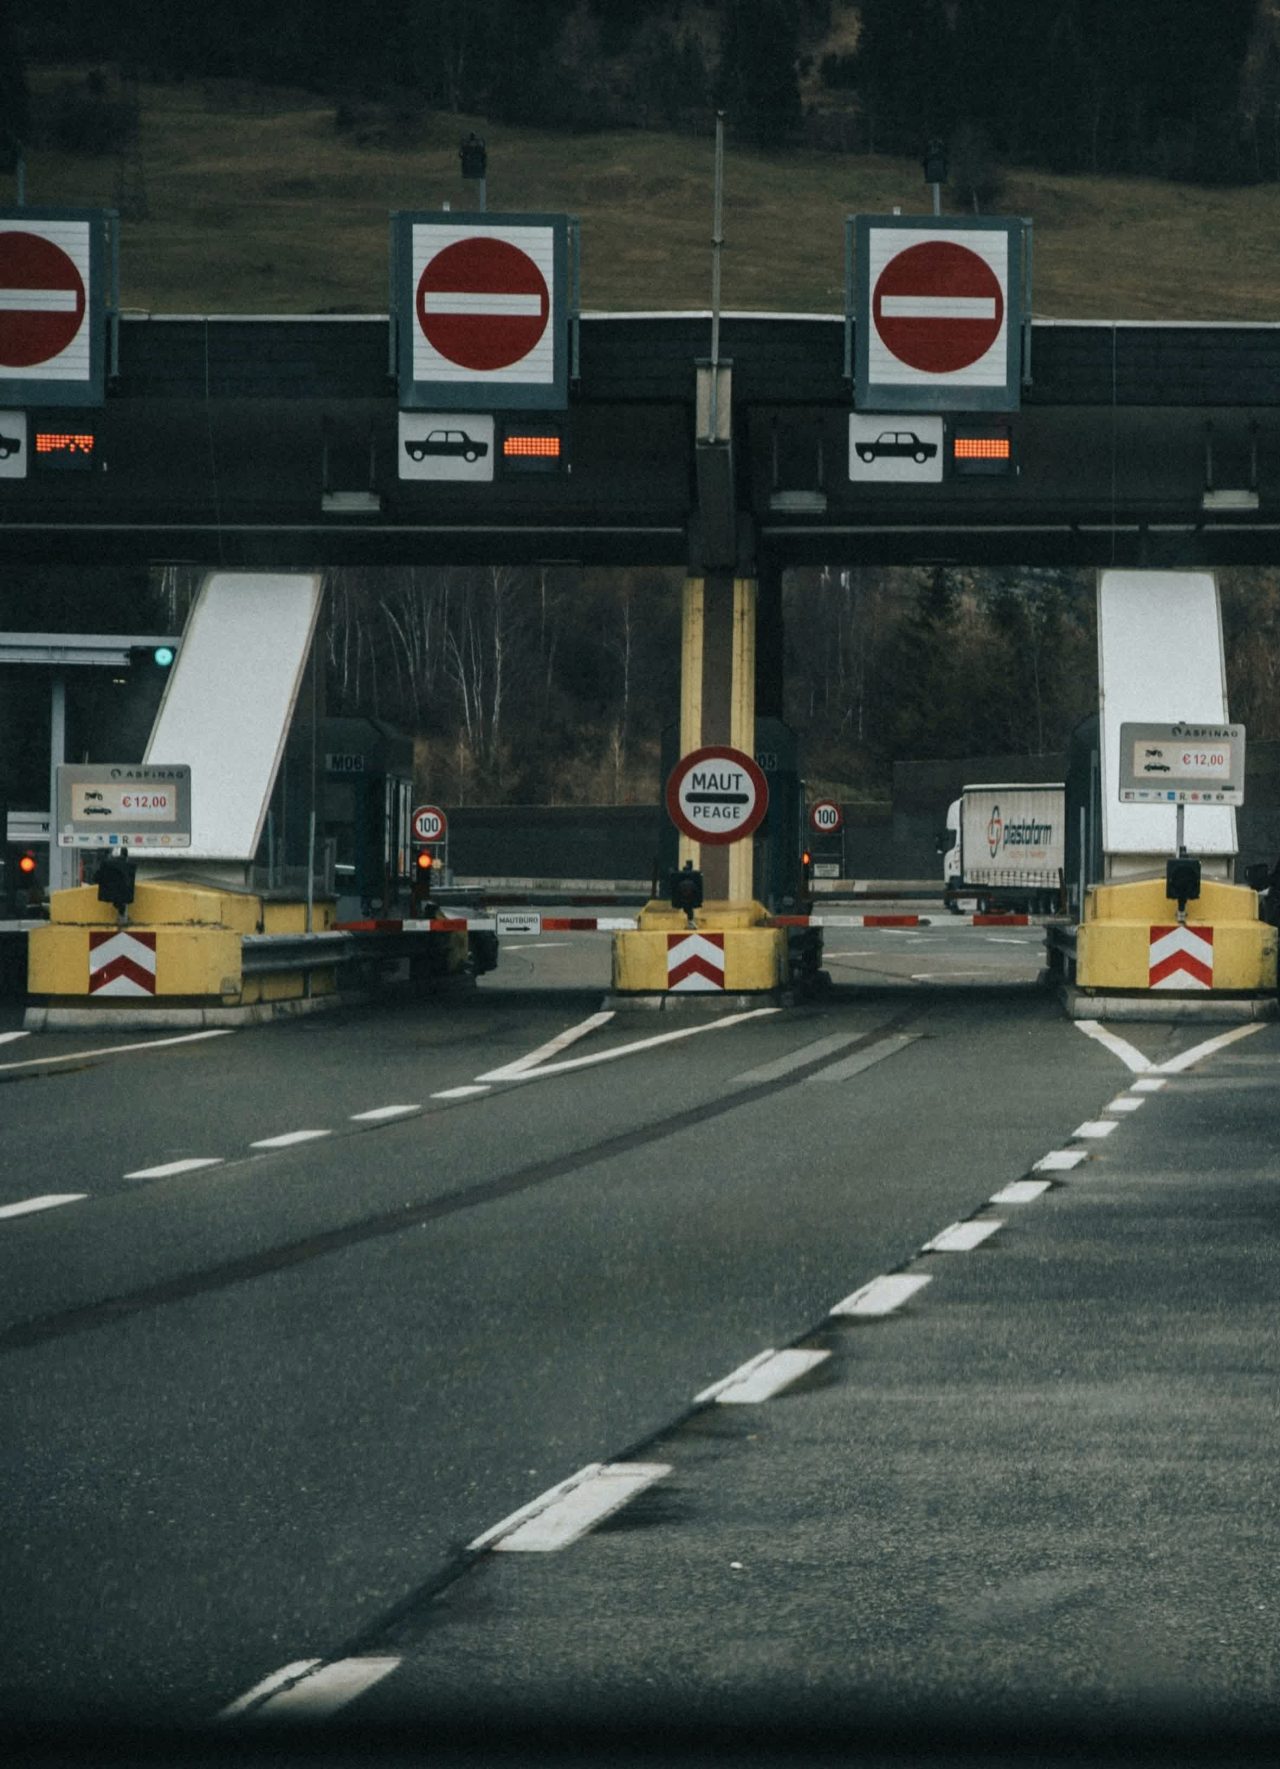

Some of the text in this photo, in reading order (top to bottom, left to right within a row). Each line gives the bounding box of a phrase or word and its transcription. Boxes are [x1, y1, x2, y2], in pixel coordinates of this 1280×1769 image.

[692, 773, 743, 791] MAUT
[693, 806, 741, 819] PEAGE
[818, 810, 836, 824] 100
[419, 818, 439, 832] 100
